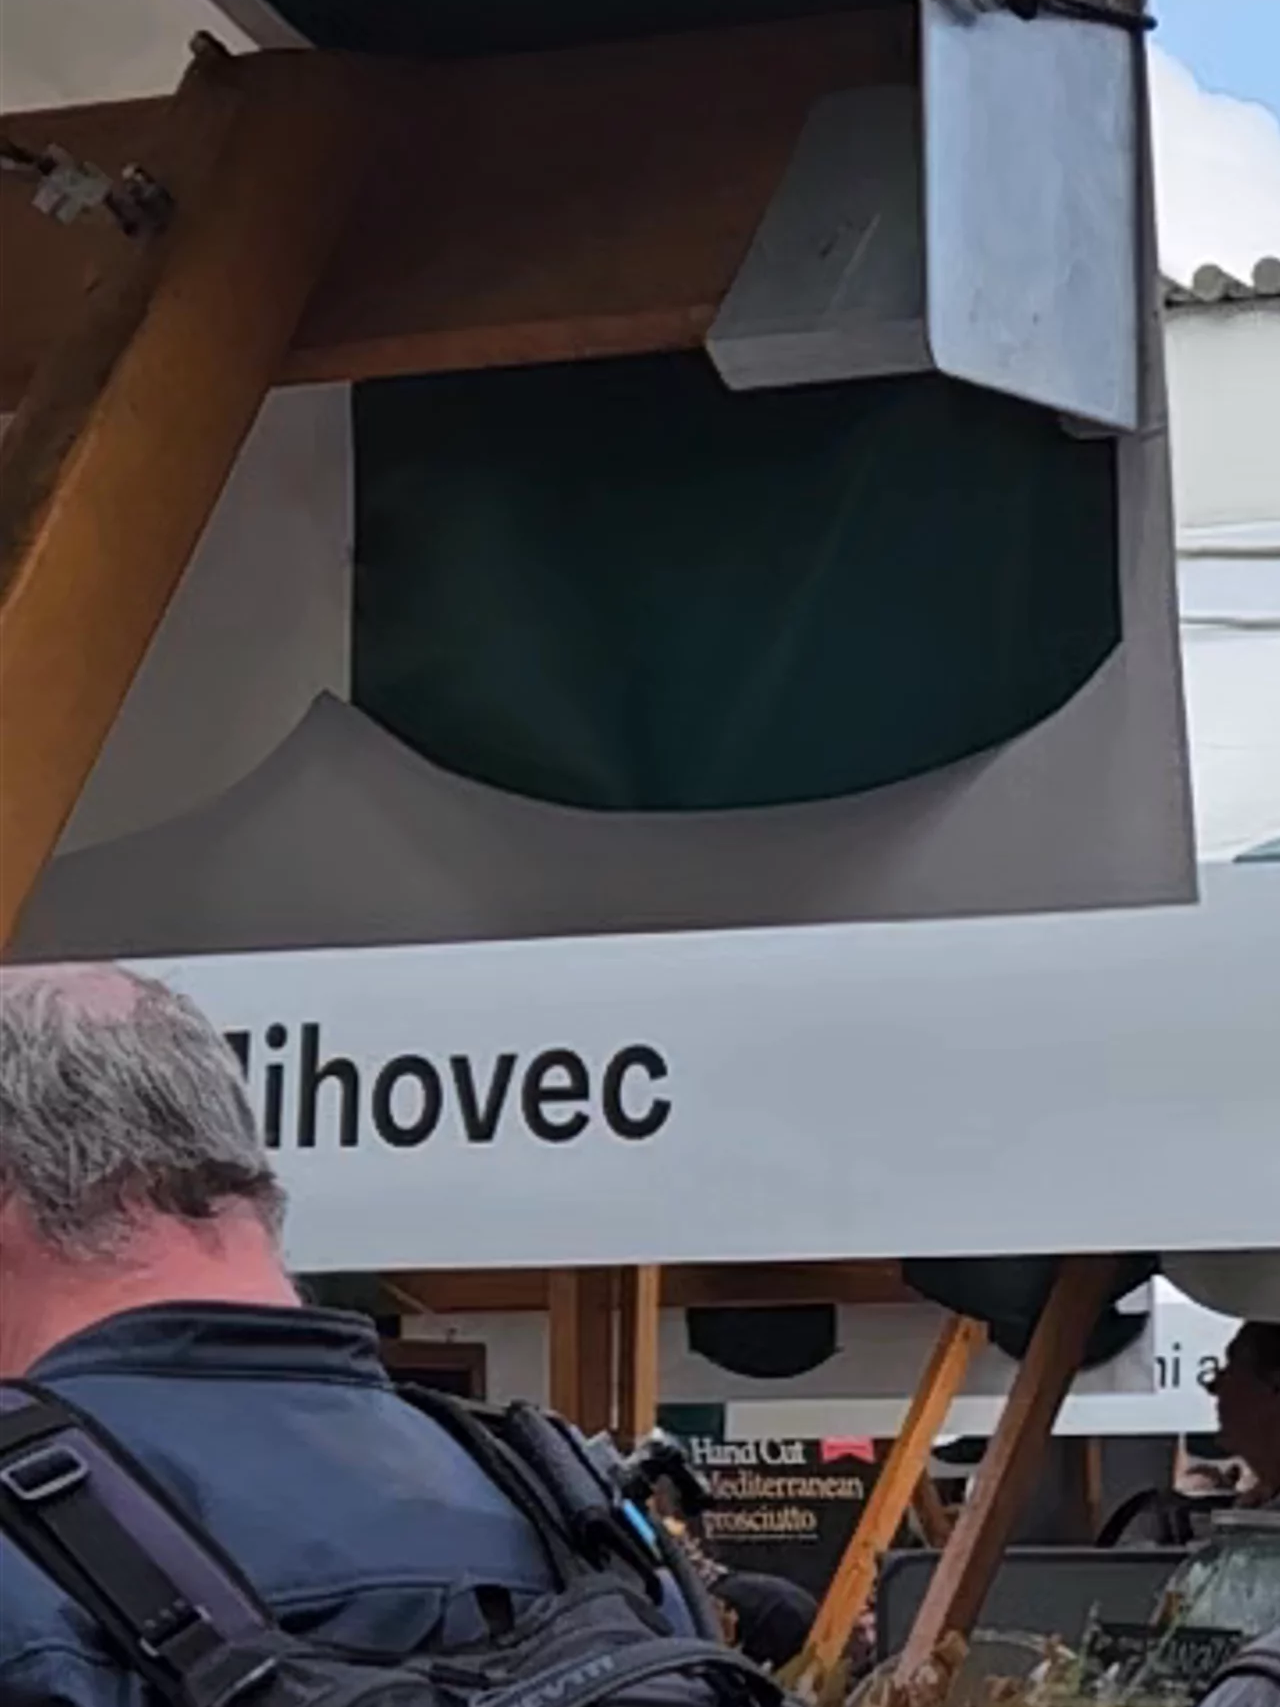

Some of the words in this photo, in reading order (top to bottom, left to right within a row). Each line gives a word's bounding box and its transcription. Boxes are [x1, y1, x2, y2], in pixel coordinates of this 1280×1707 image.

[222, 1022, 672, 1148] ihovec
[689, 1437, 757, 1465] Hand
[758, 1438, 807, 1465] Cut
